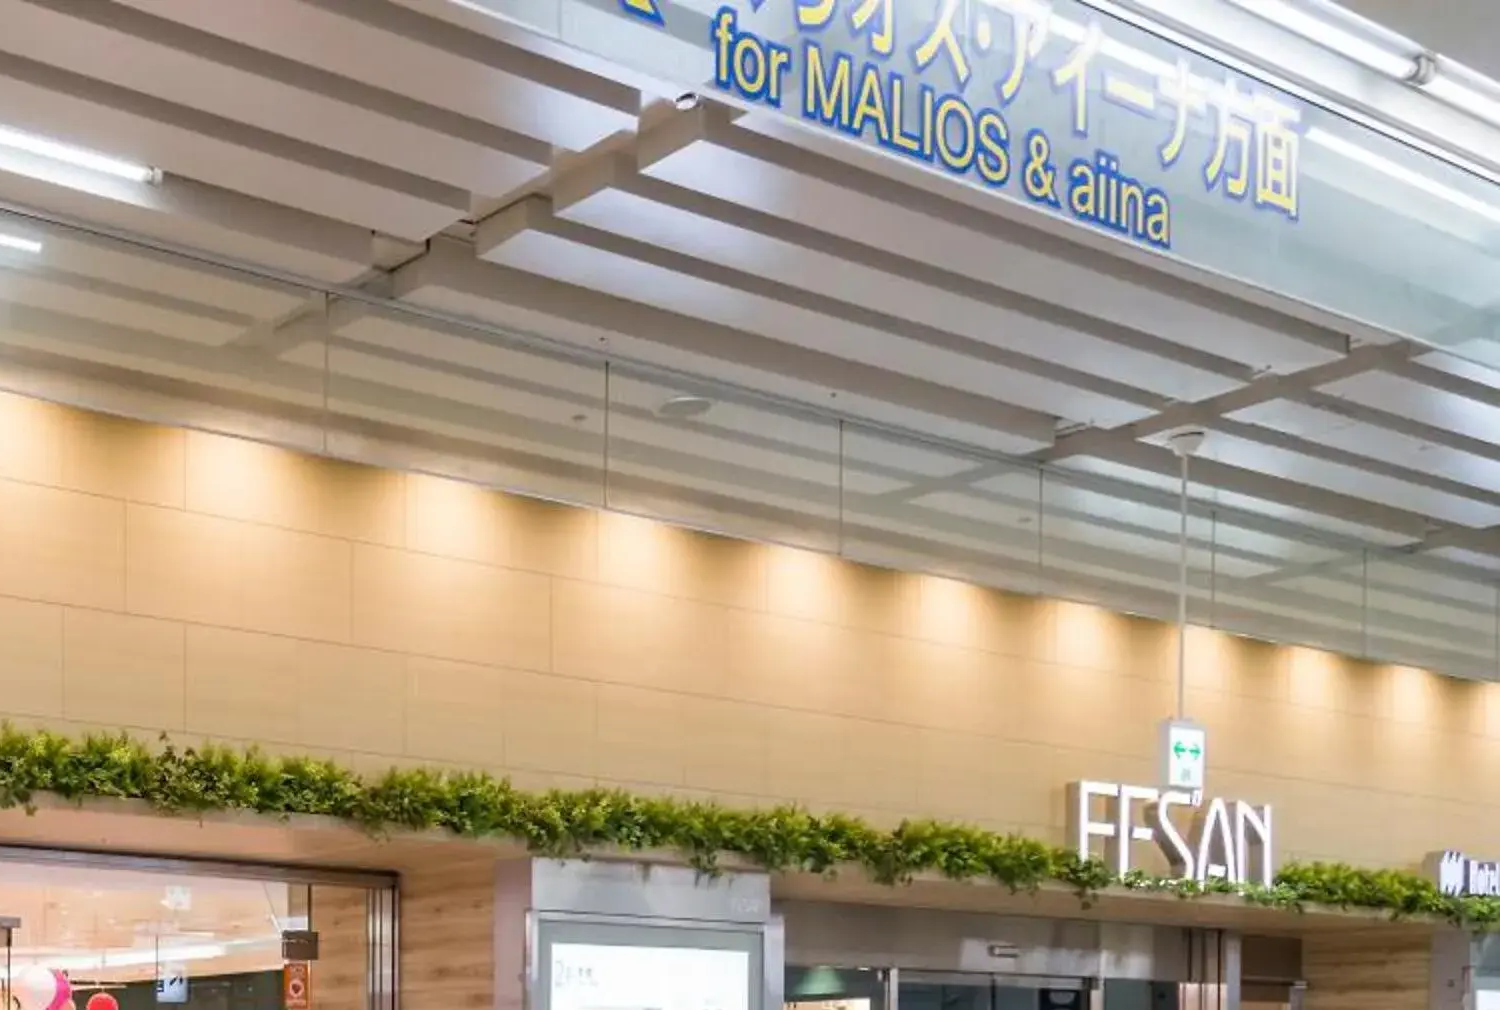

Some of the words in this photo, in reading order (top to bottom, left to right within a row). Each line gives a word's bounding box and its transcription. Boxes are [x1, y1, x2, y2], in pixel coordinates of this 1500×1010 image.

[712, 6, 790, 106] for
[803, 41, 1009, 185] MALIOS
[1024, 129, 1060, 207] &
[1070, 151, 1170, 248] aiina
